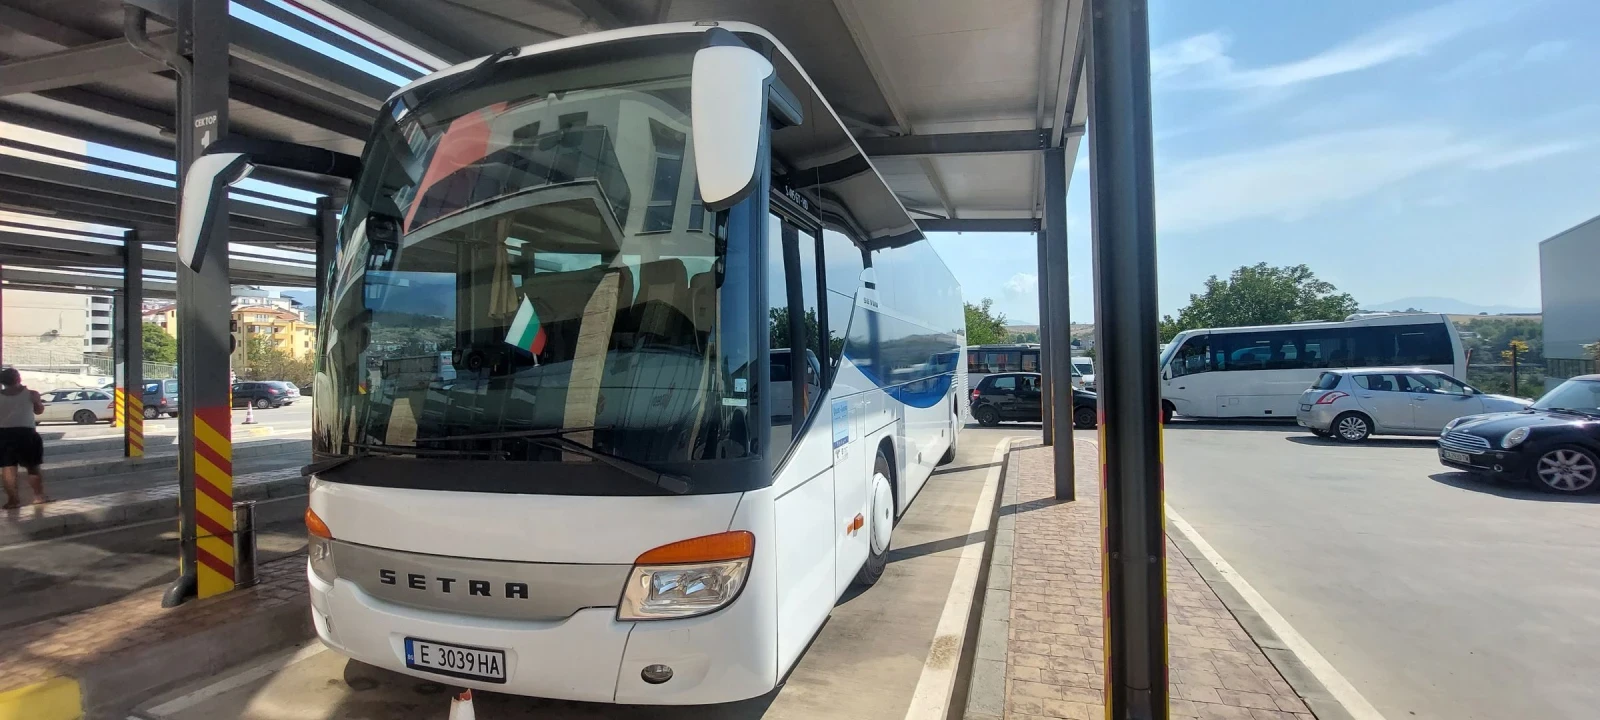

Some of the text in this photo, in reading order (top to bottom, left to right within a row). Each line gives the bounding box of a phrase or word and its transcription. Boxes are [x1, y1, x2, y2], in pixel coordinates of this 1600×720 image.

[194, 115, 217, 128] СЕКТОР
[201, 130, 210, 149] 1
[379, 568, 529, 599] SETRA
[420, 645, 500, 675] E 3039 HA
